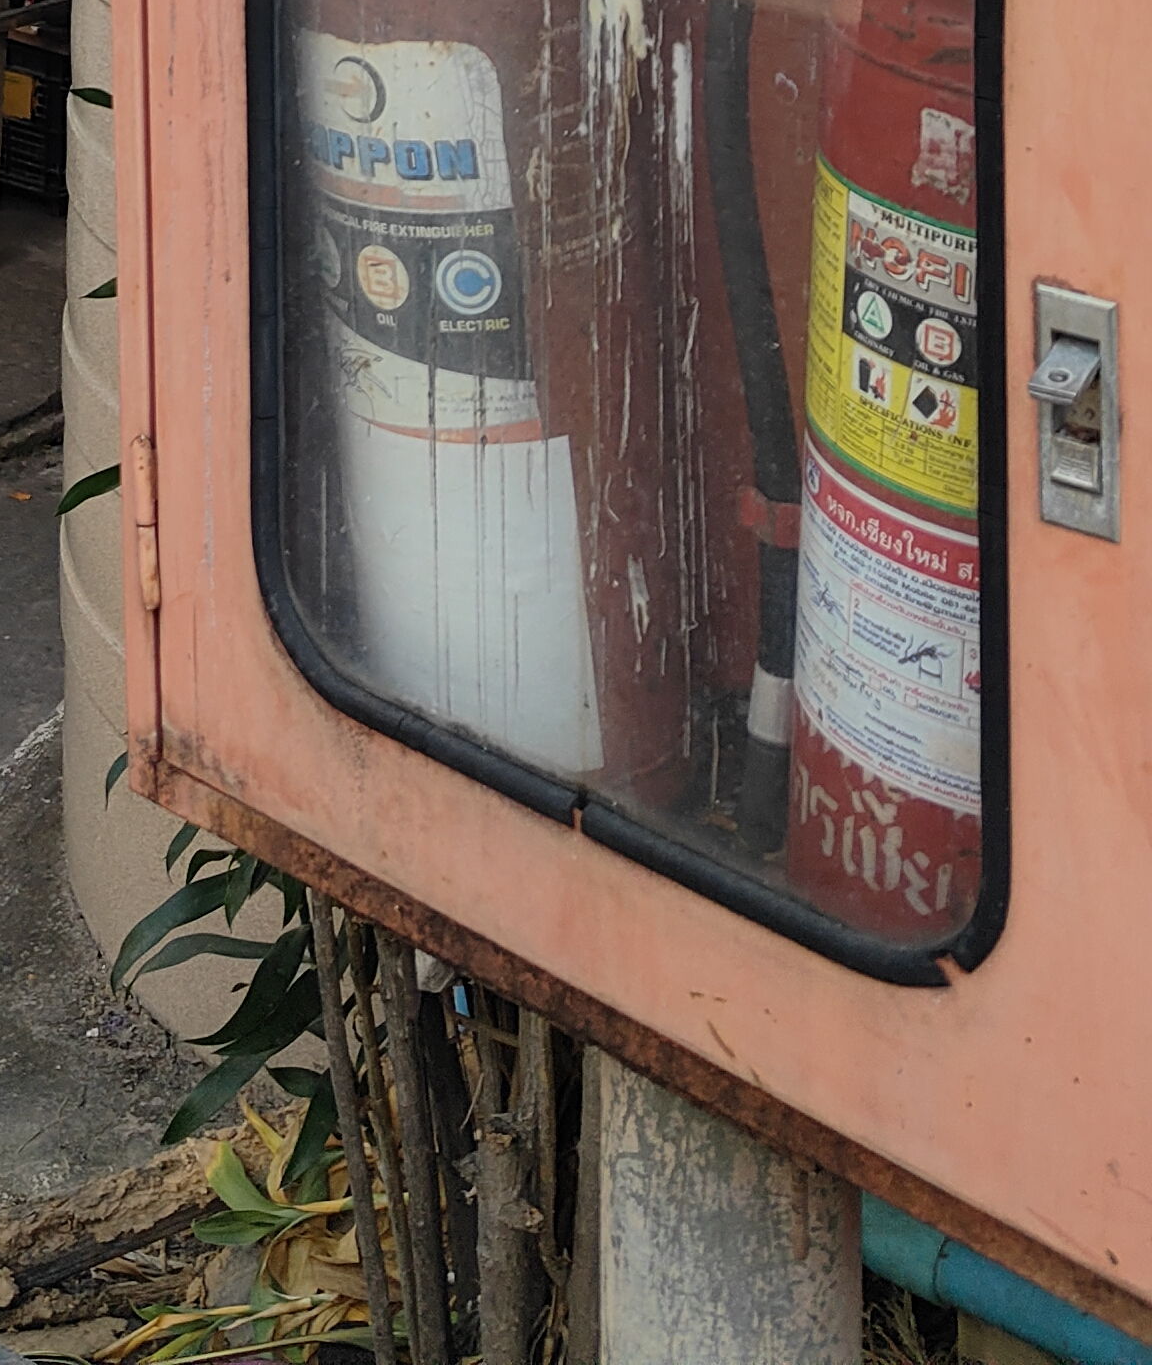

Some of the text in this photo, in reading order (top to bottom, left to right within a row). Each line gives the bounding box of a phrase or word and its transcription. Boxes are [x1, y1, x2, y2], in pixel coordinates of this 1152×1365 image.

[362, 218, 389, 235] FIRE
[376, 312, 511, 333] OIL ELECTRIC
[859, 395, 943, 439] SPECIFICATIONS
[826, 495, 947, 572] หจก.เชียงใหม่
